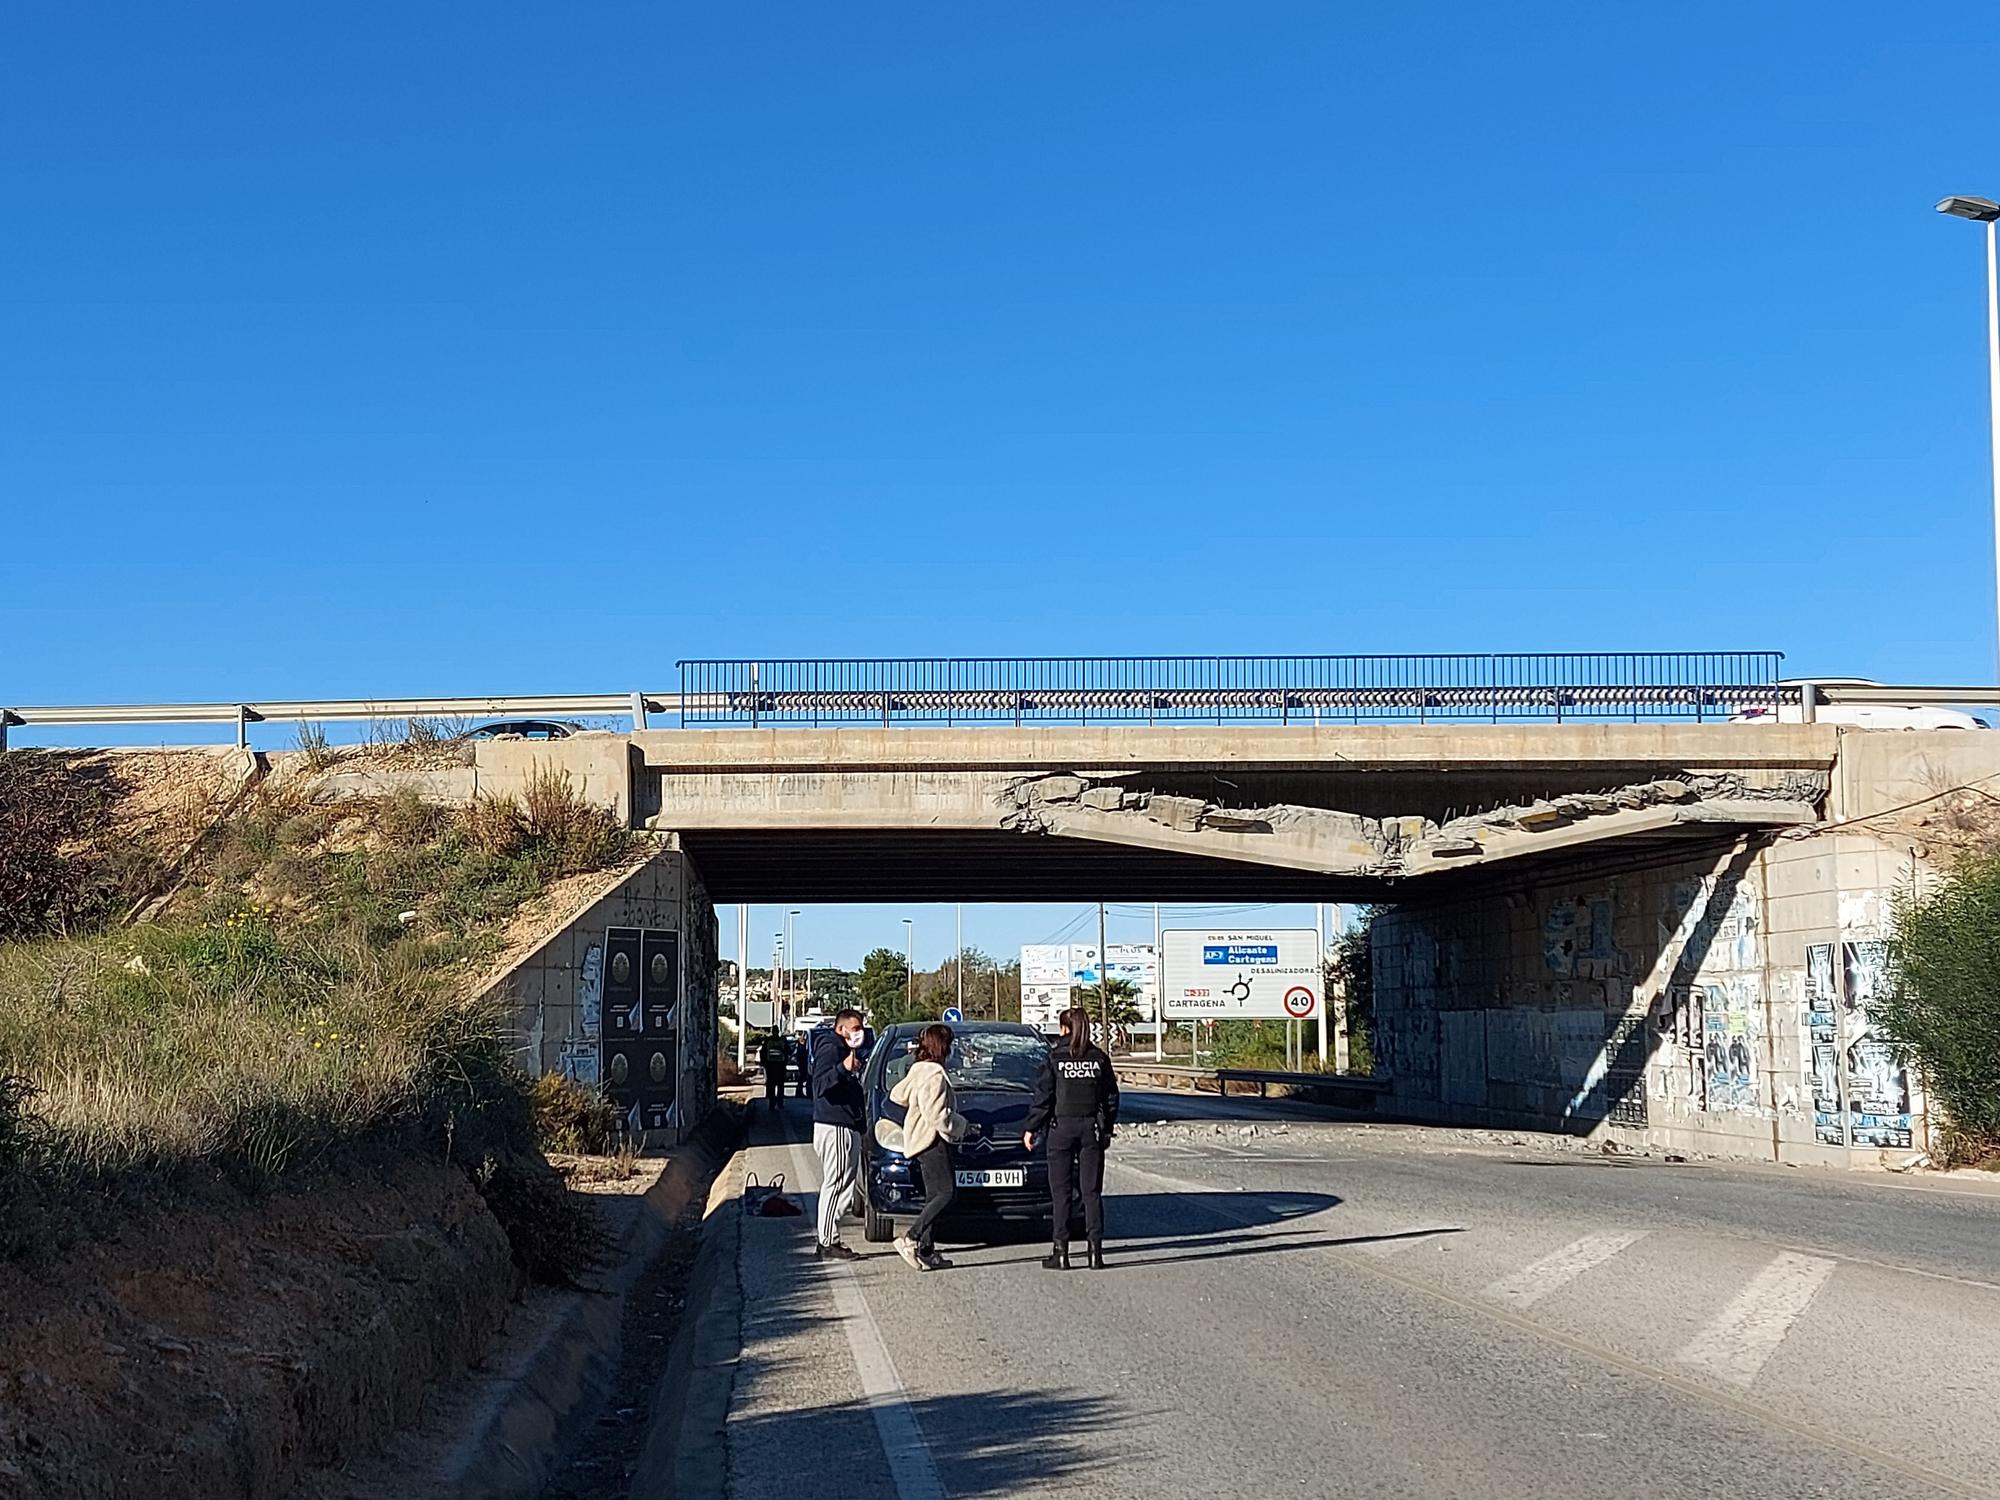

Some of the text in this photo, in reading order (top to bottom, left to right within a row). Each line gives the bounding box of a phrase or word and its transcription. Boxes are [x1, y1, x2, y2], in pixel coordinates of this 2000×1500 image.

[1228, 946, 1268, 954] Alicante
[1228, 955, 1277, 964] Cartagena
[1168, 1000, 1226, 1008] CARTAGENA
[1290, 996, 1309, 1007] 40
[1058, 1061, 1101, 1071] POLICIA
[1064, 1070, 1096, 1079] LOCAL
[958, 1172, 1020, 1185] 4540 BVH
